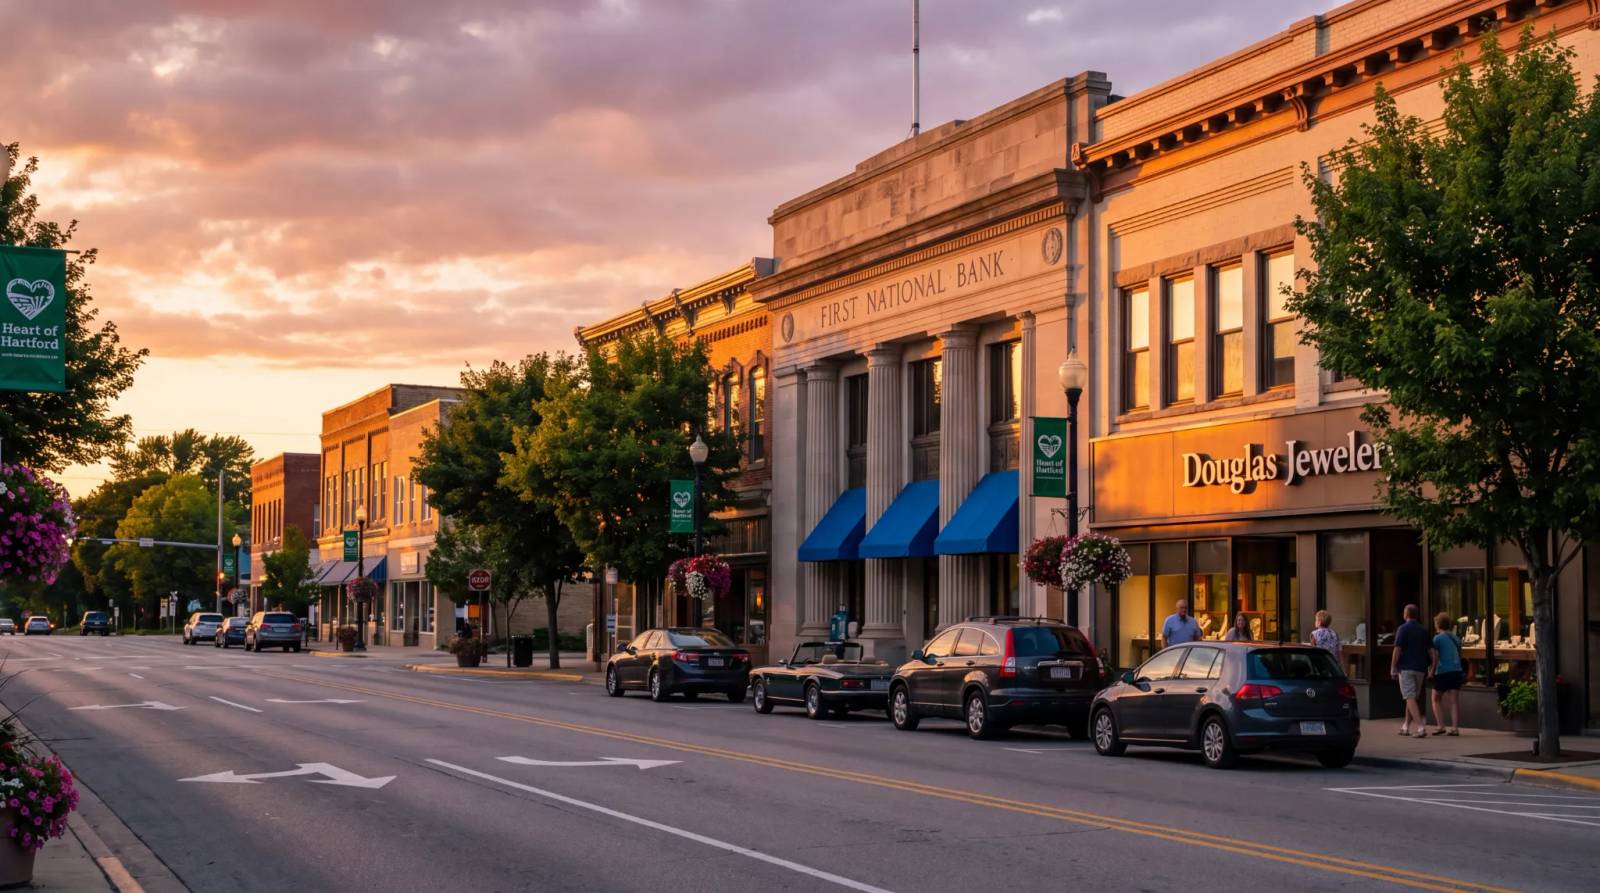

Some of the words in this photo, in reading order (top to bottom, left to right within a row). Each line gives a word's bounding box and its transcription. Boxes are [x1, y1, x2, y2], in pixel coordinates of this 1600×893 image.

[821, 297, 859, 329] FIRST
[866, 269, 945, 315] NATIONAL
[957, 251, 1004, 288] BANK
[1, 336, 59, 350] Hartford
[2, 323, 41, 336] Heart
[43, 325, 59, 336] of
[1182, 443, 1278, 495] Douglas
[1284, 430, 1398, 486] Jeweler
